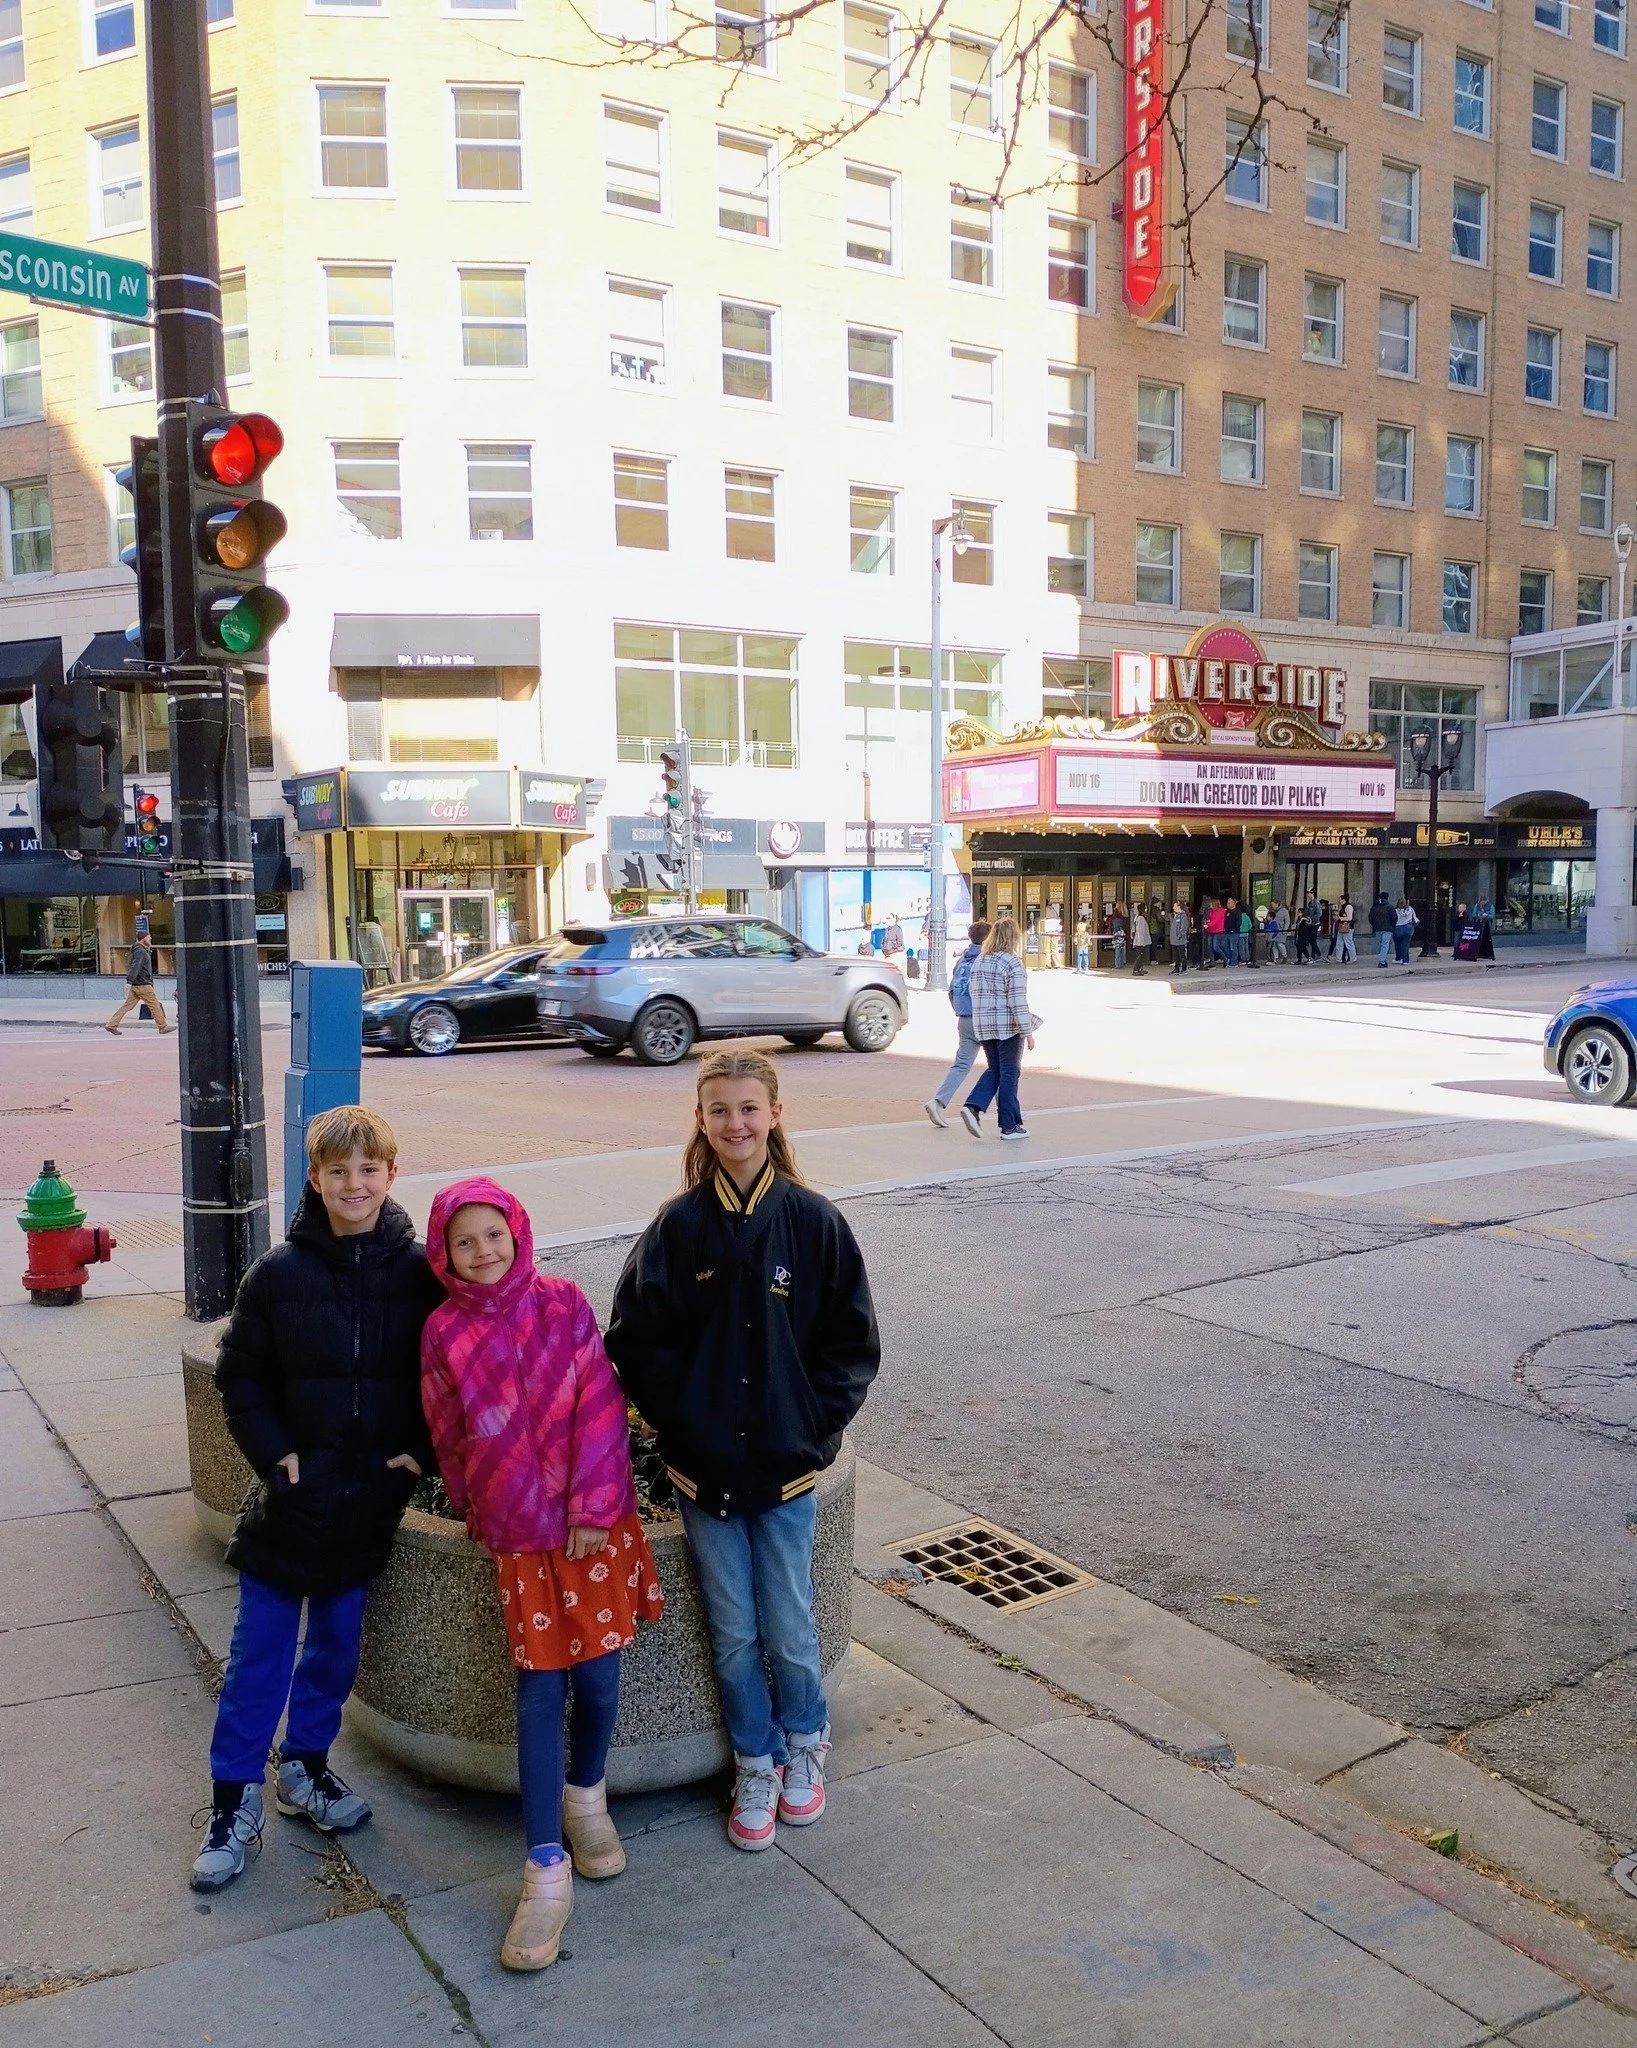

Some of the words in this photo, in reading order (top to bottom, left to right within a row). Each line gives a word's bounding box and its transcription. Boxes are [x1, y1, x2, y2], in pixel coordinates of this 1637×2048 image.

[118, 277, 140, 298] AV
[1112, 648, 1347, 729] RIVERSIDE
[1069, 772, 1084, 788] NOV
[1089, 774, 1100, 789] 16
[1197, 765, 1208, 779] AN
[1210, 765, 1254, 780] AFTERNOON
[1256, 766, 1276, 781] WITH
[300, 781, 334, 806] SUBWAY
[1139, 781, 1166, 803] DOG
[1170, 782, 1200, 804] MAN
[1204, 784, 1257, 806] CREATOR
[1261, 785, 1285, 806] DAV
[1288, 786, 1327, 807] PILKEY
[1360, 783, 1376, 797] NOV
[1378, 784, 1385, 797] 16
[316, 805, 333, 821] Cafe
[431, 800, 470, 821] Cafe
[554, 803, 578, 822] Cafe
[632, 829, 662, 841] $5.00
[870, 828, 905, 848] OFFICE
[1528, 826, 1583, 839] UHLE'S
[1289, 836, 1314, 845] FINEST
[1315, 836, 1340, 846] CIGARS
[1341, 837, 1347, 845] &
[1347, 837, 1379, 846] TOBACCO
[1517, 839, 1538, 847] FINEST
[1539, 839, 1560, 847] CIGARS
[1566, 839, 1592, 847] TOBACCO
[619, 901, 641, 911] OPEN
